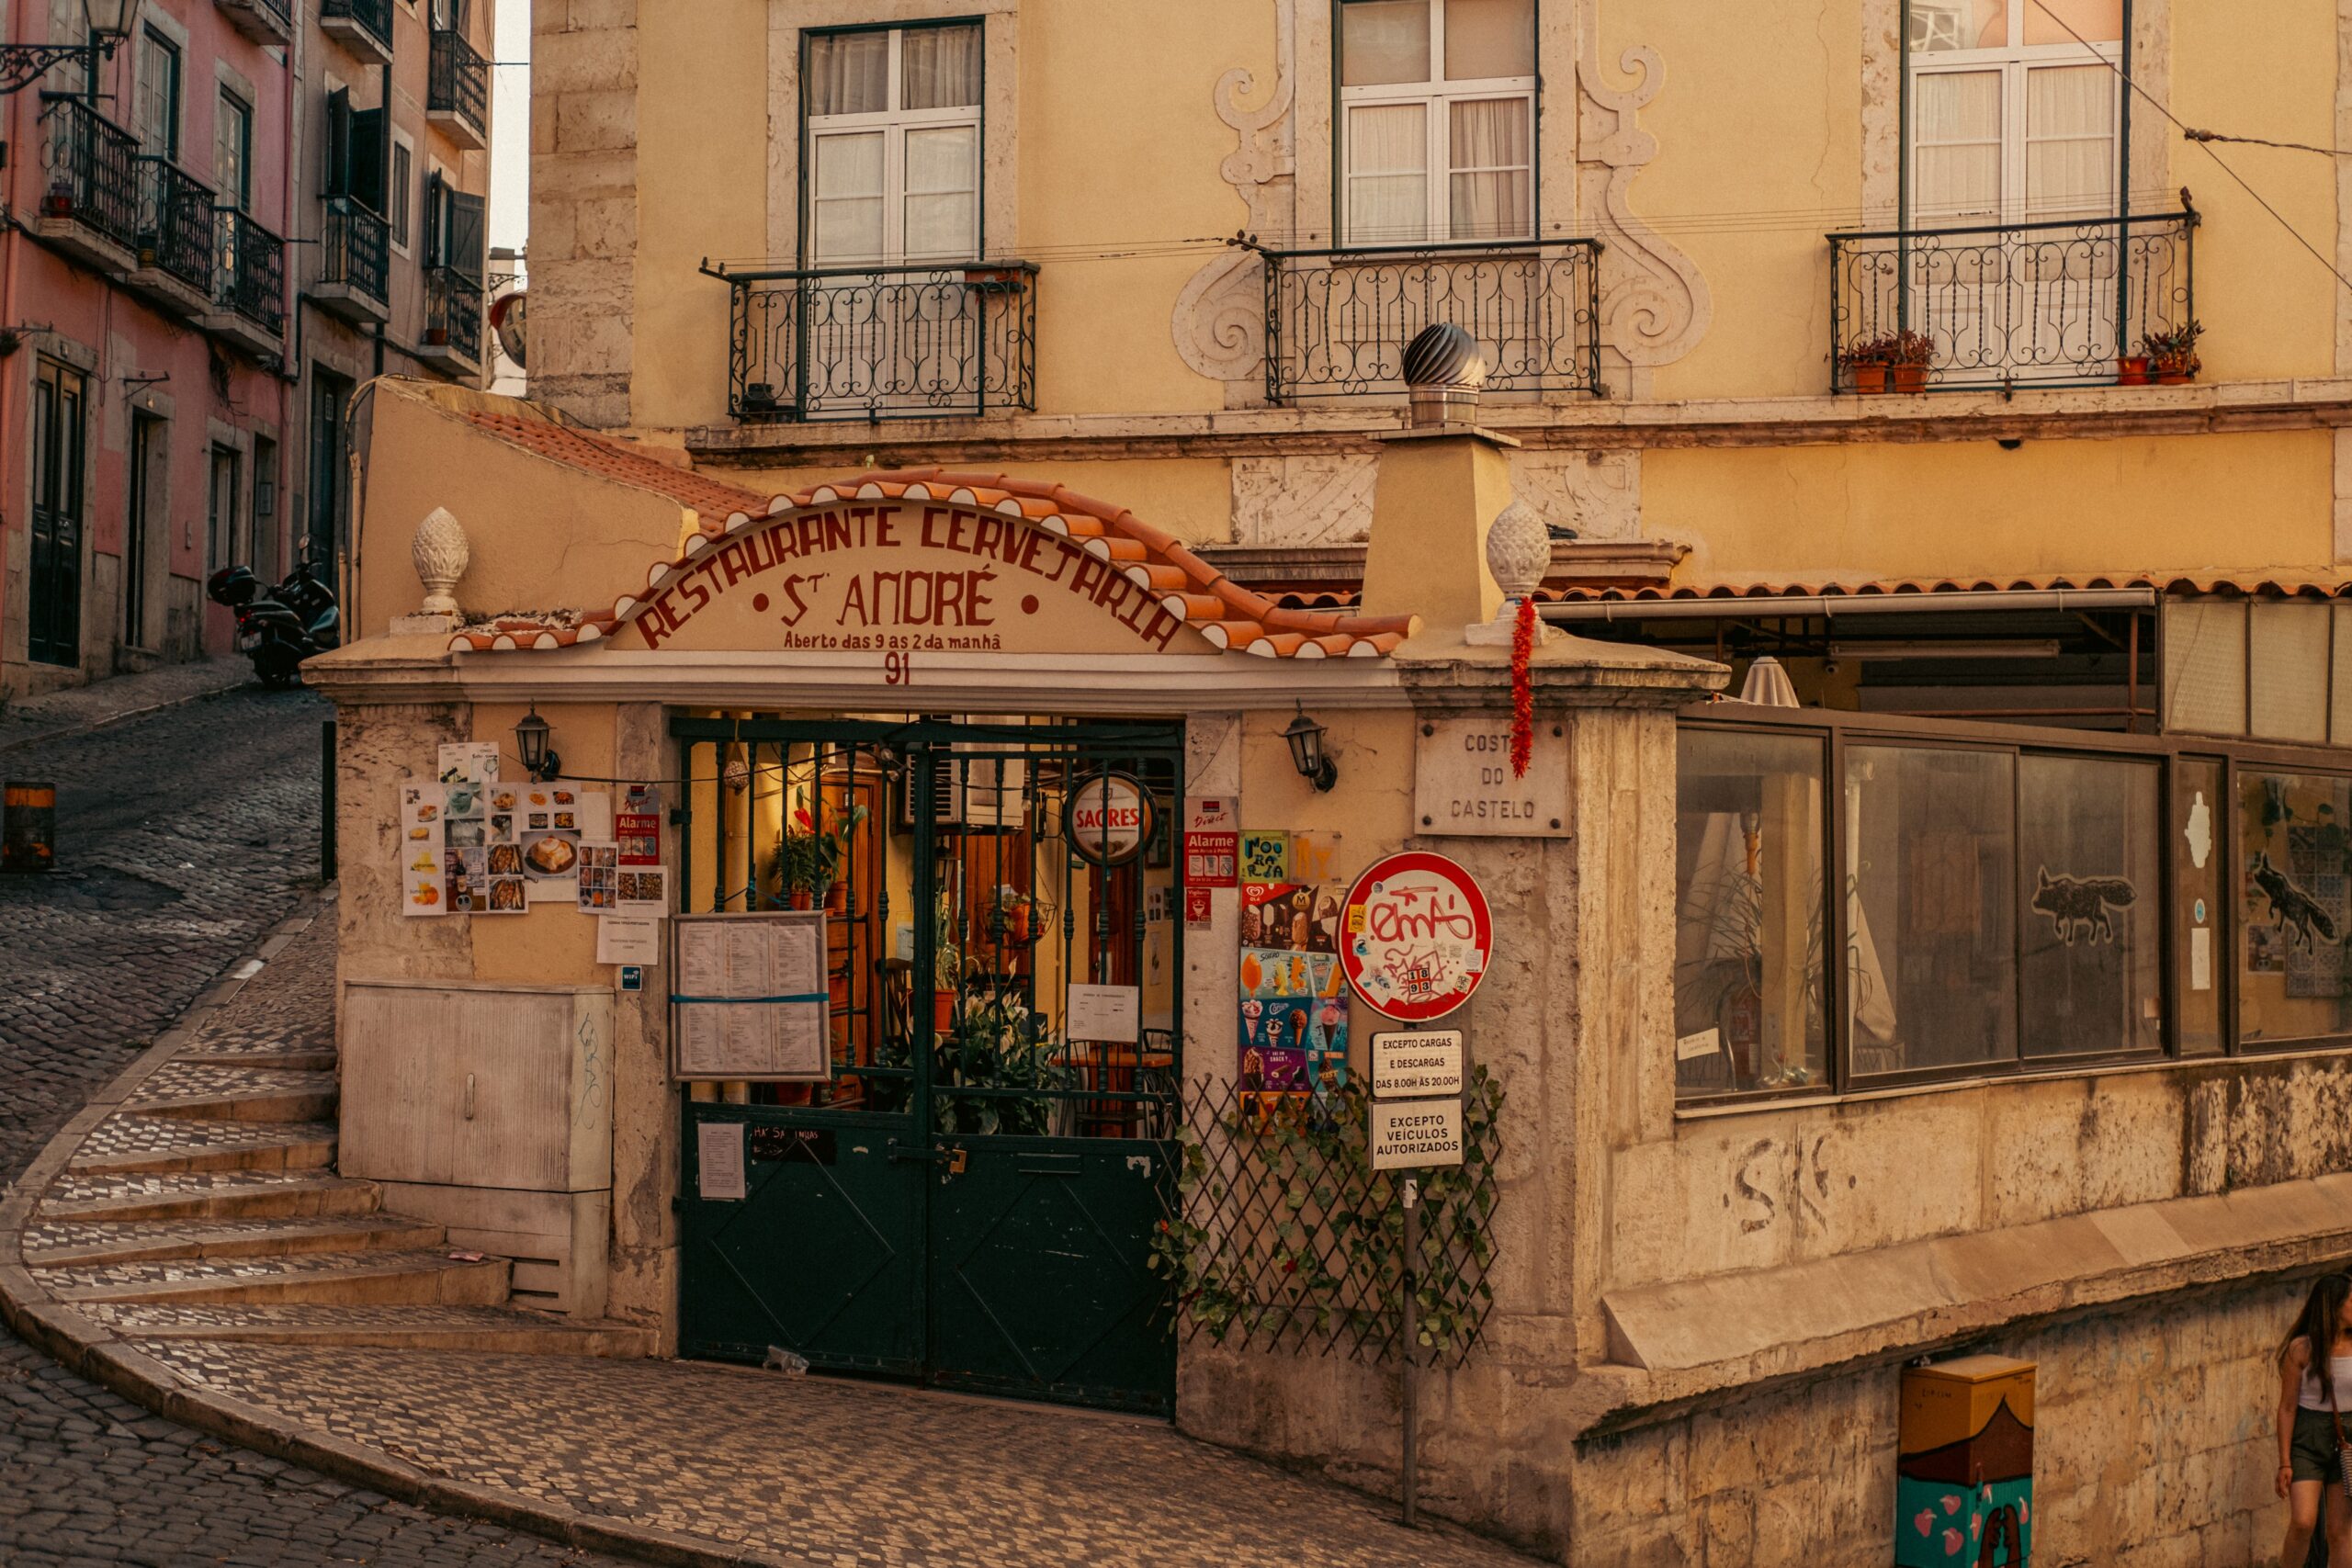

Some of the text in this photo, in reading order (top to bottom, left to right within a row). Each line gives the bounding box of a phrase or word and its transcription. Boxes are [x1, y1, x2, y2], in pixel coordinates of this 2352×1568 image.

[635, 505, 1186, 653] RESTAURANTE CERVEJARIA
[836, 563, 999, 627] ANDRÉ
[784, 631, 837, 649] Aberto
[842, 634, 870, 649] das
[876, 634, 885, 649] 9
[889, 634, 908, 649] as
[912, 634, 922, 649] 2
[924, 634, 944, 649] da
[885, 651, 910, 685] 91
[1464, 734, 1512, 752] COST
[1481, 768, 1504, 785] DO
[1451, 799, 1535, 819] CASTELO
[619, 817, 657, 829] Alarme
[1189, 834, 1234, 847] Alarme
[1383, 1037, 1452, 1049] EXCEPTO CARGAS
[1390, 1057, 1445, 1069] E DESCARGAS
[1375, 1079, 1392, 1089] DAS
[1394, 1078, 1418, 1089] 8.00H
[1431, 1077, 1460, 1086] 20.00H
[1390, 1115, 1444, 1128] EXCEPTO
[1387, 1128, 1448, 1141] VEÍCULOS
[1376, 1141, 1459, 1156] AUTORIZADOS
